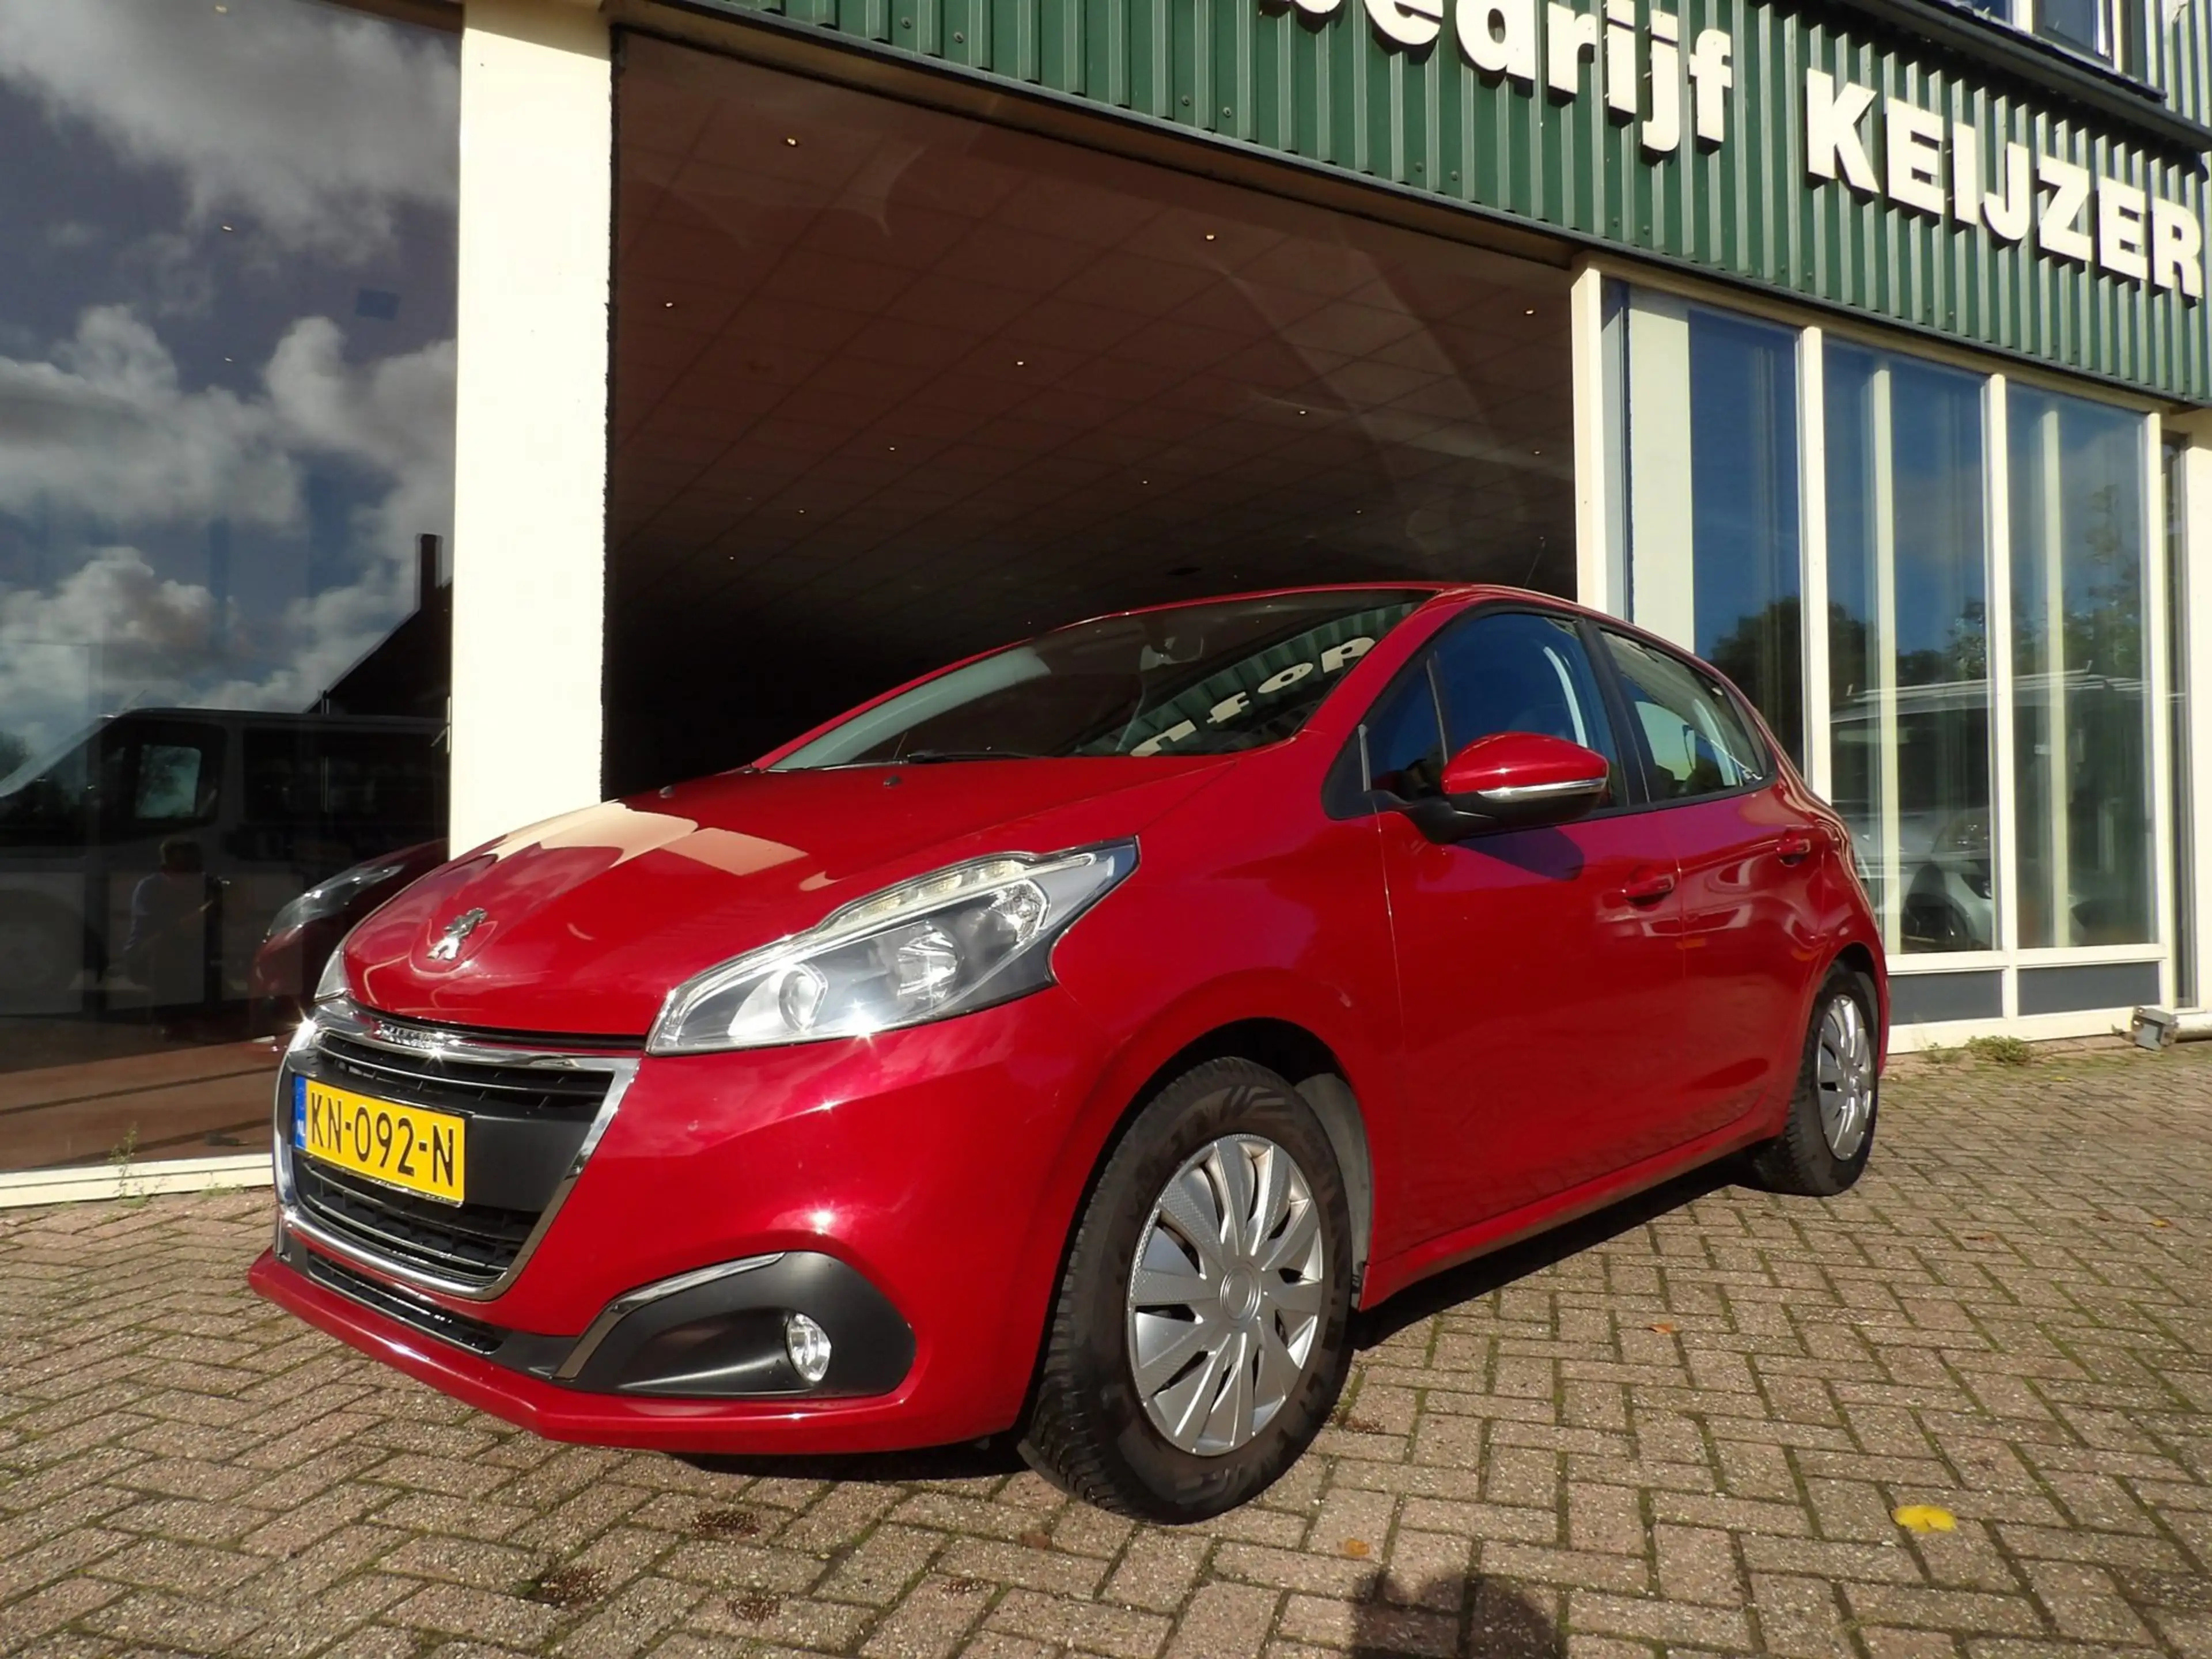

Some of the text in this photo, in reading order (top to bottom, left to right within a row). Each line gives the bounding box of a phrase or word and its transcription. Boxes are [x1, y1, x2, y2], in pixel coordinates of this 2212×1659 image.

[1290, 0, 2203, 298] edrijf KEIJZER
[311, 1092, 454, 1187] KN-092-N
